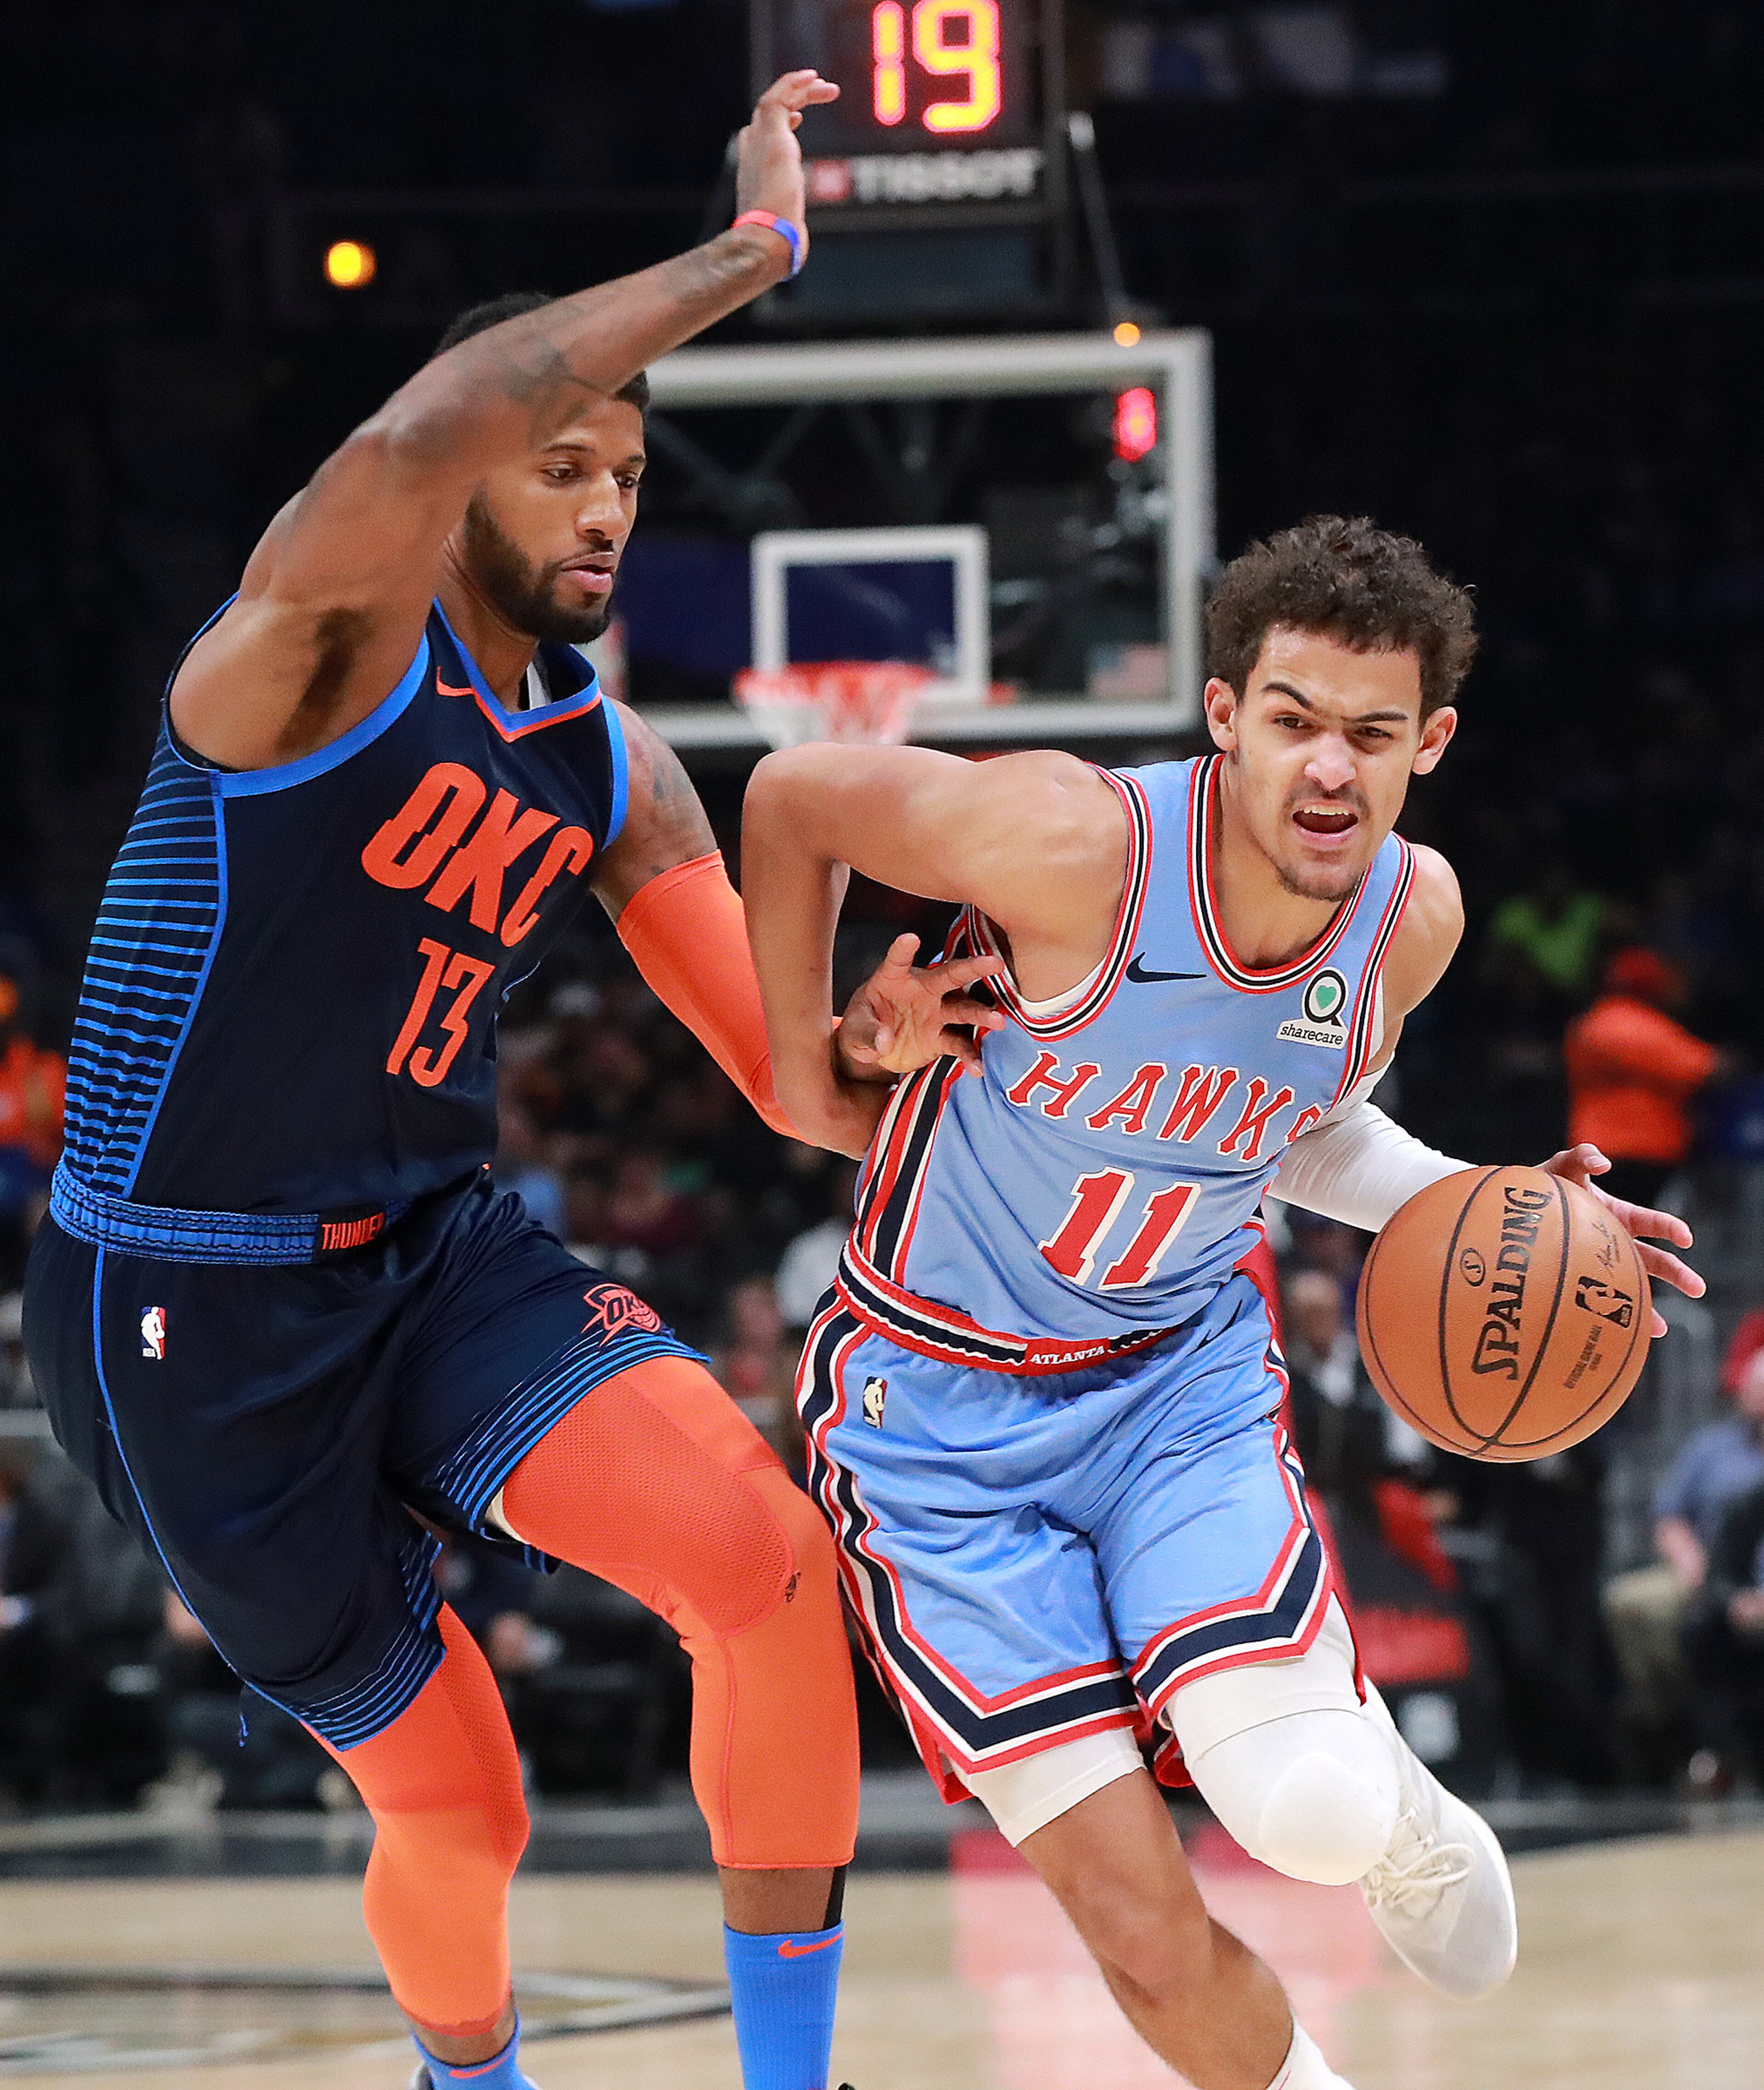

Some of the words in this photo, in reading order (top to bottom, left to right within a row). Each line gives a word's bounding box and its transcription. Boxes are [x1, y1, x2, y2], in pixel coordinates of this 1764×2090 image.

[872, 0, 1001, 133] 19
[361, 762, 594, 947] OKC
[387, 937, 496, 1087] 13
[1280, 1024, 1343, 1045] sharecare
[1036, 1166, 1201, 1290] 11
[1472, 1187, 1554, 1381] SPALDING
[1029, 1346, 1105, 1364] ATLANTA
